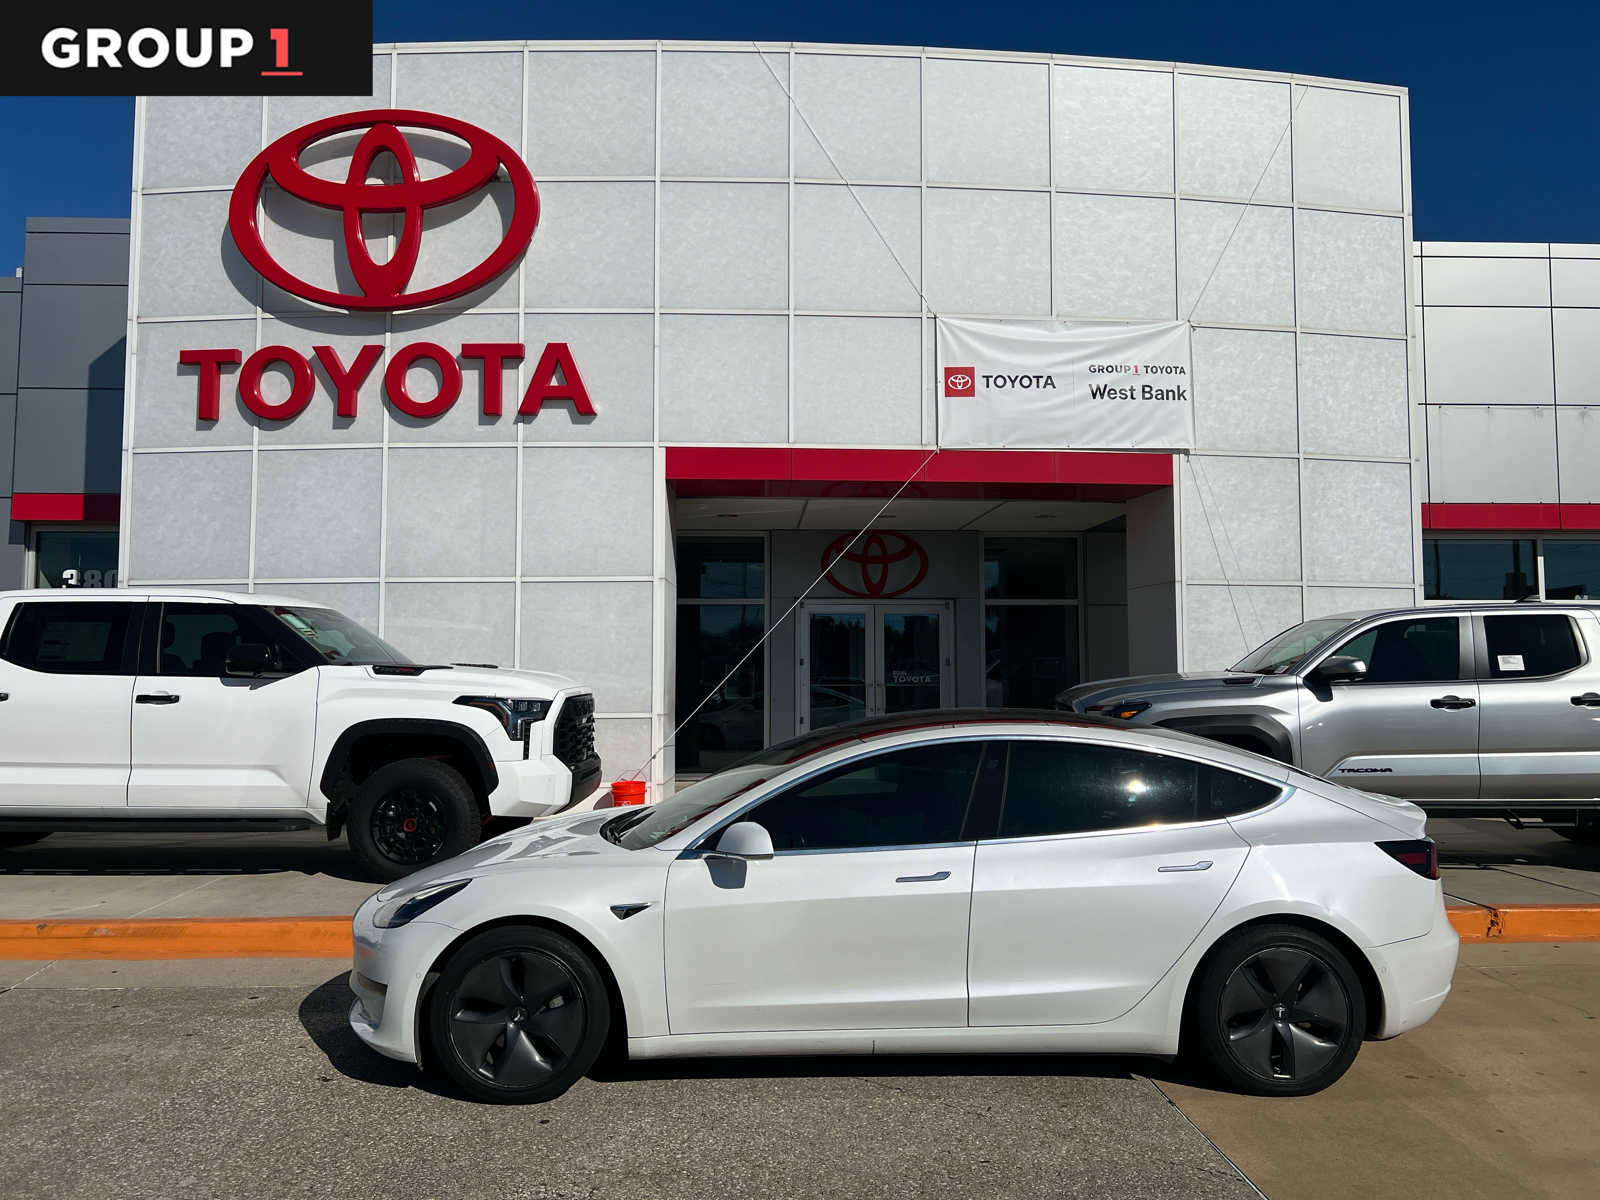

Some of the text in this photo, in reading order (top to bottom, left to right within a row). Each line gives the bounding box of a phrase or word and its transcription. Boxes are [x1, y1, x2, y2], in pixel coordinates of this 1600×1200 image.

[1088, 364, 1131, 374] GROUP
[1143, 365, 1186, 375] TOYOTA
[179, 342, 598, 421] TOYOTA
[982, 374, 1056, 389] TOYOTA
[1088, 383, 1187, 401] West Bank
